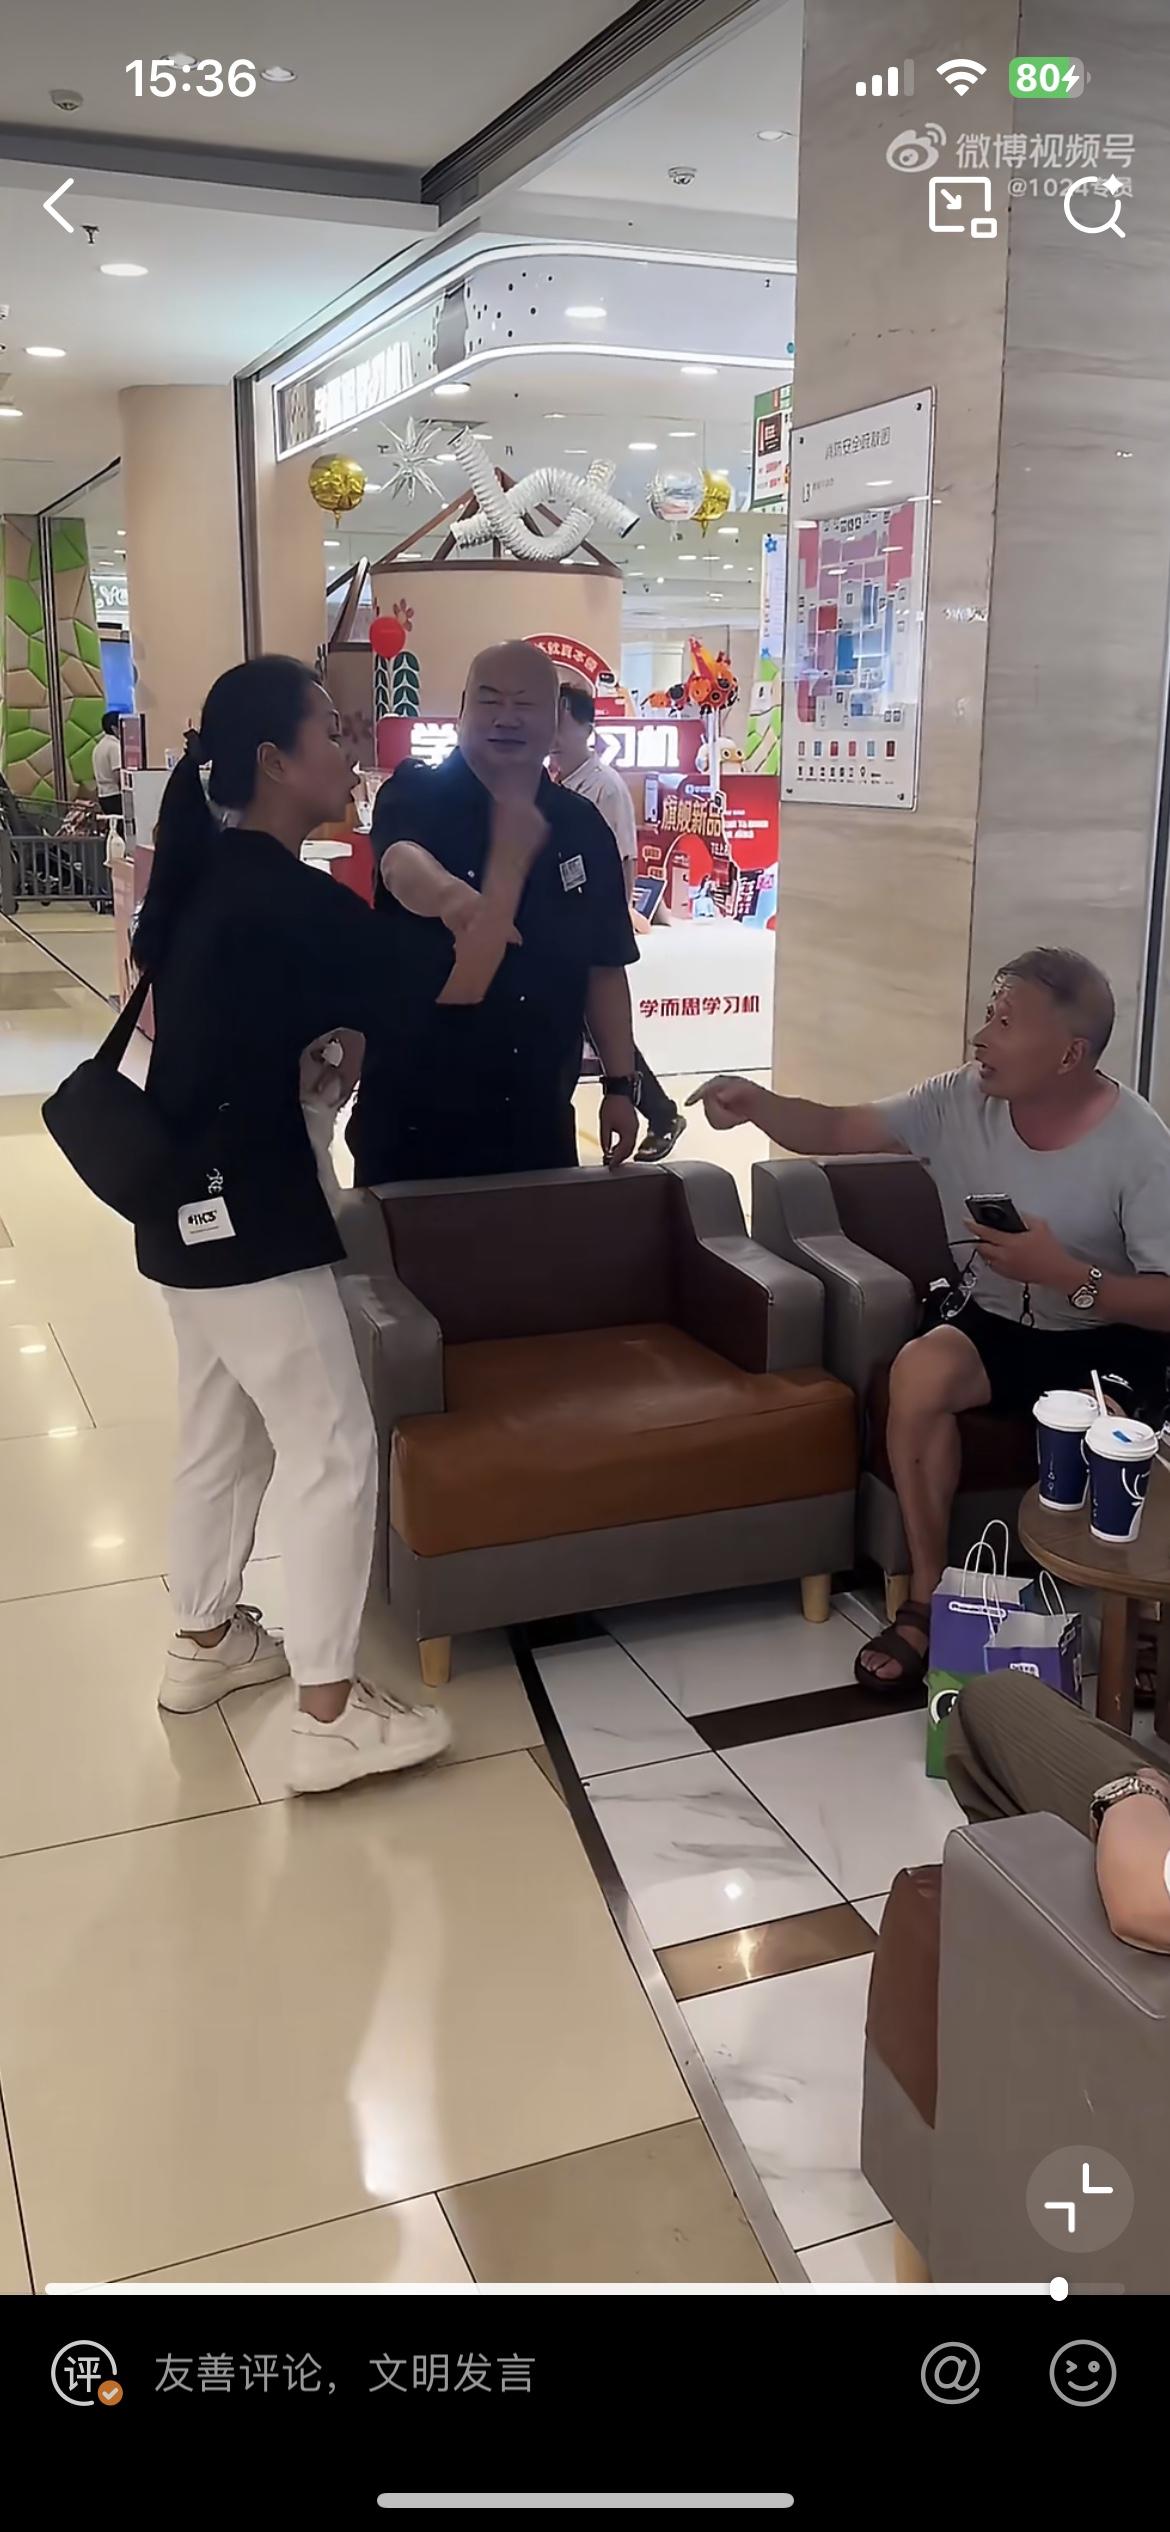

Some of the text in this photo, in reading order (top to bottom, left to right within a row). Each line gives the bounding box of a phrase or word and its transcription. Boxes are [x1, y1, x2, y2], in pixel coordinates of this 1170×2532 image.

[661, 794, 723, 836] 旗舰新品
[639, 995, 760, 1018] 学而思学习机
